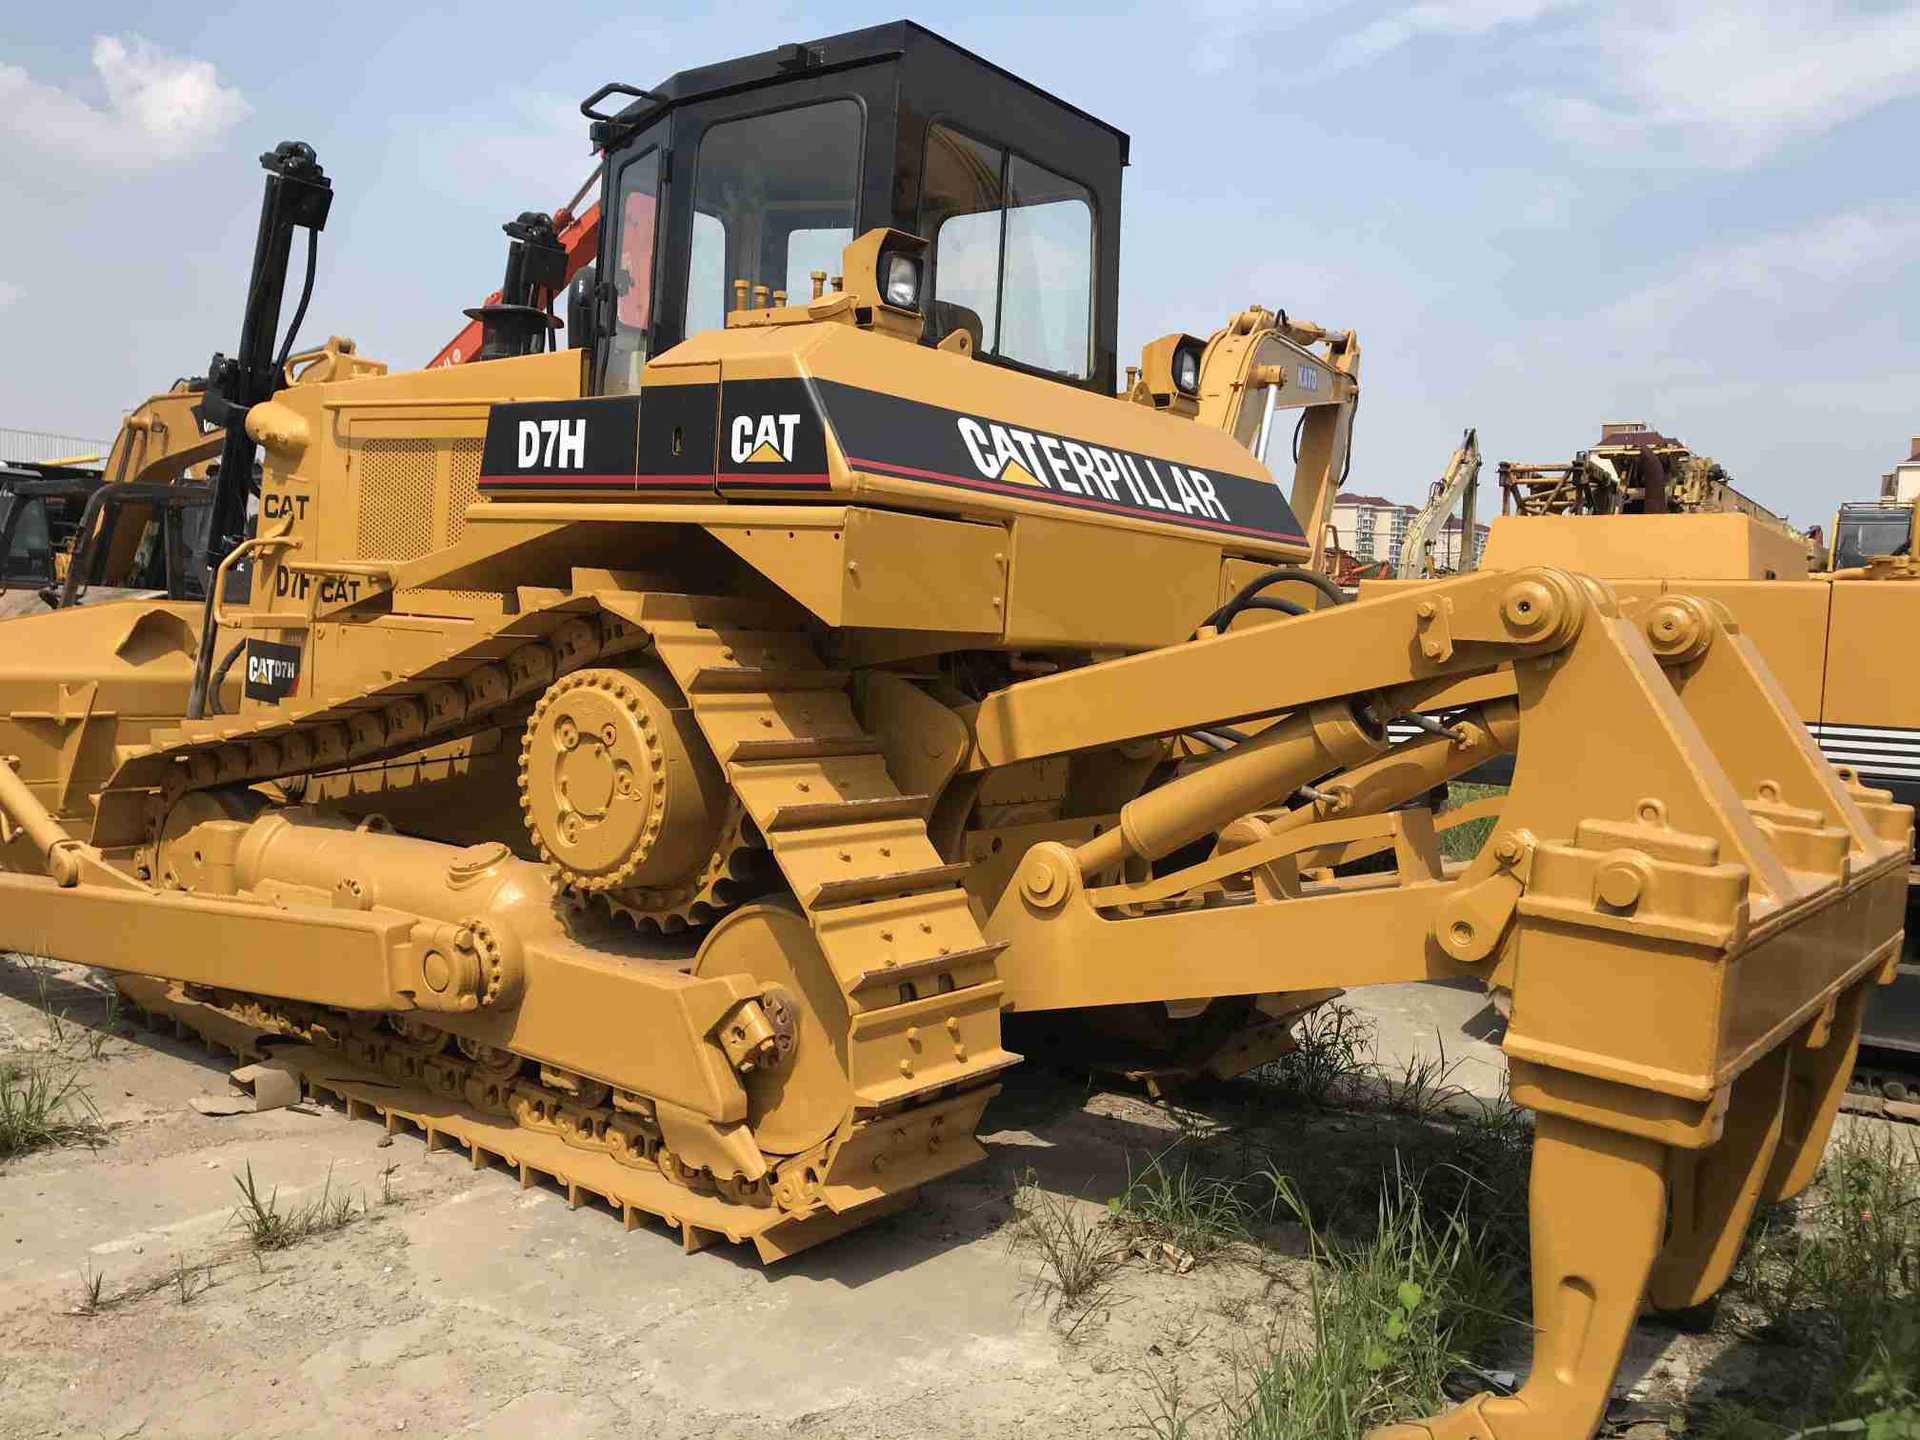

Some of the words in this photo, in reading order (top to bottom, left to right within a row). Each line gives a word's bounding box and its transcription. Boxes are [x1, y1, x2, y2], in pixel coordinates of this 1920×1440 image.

[517, 418, 586, 469] D7H
[730, 413, 800, 464] CAT
[957, 417, 1231, 522] CATERPILLAR
[264, 494, 310, 520] CAT
[320, 578, 361, 603] CAT
[248, 655, 275, 686] CAT
[274, 659, 295, 679] D7H
